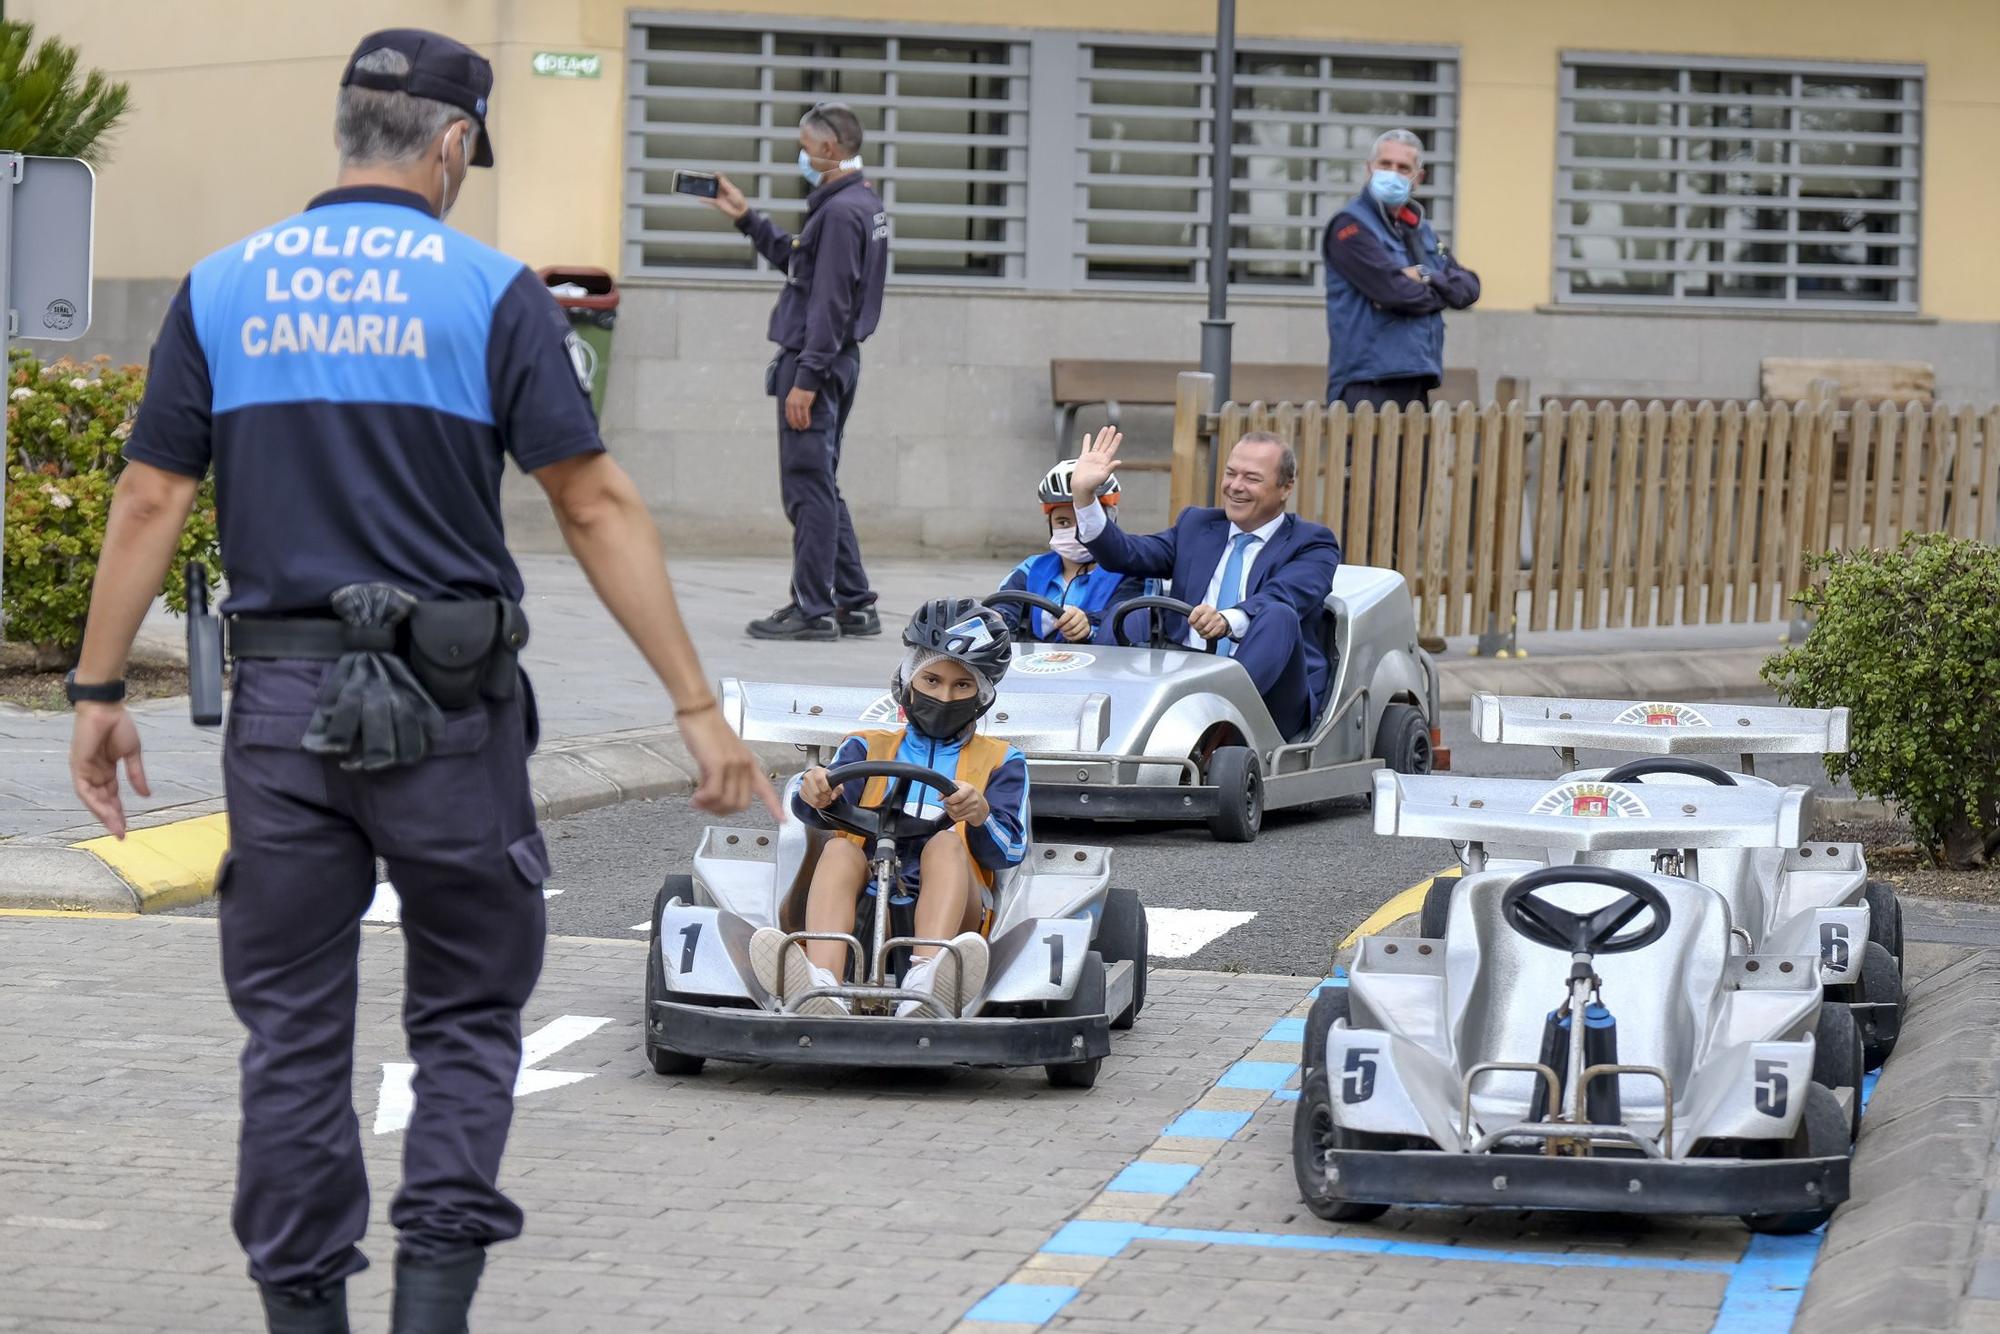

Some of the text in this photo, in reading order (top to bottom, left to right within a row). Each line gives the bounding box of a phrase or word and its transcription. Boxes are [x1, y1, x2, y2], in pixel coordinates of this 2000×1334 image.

[243, 226, 446, 264] POLICIA
[266, 267, 409, 304] LOCAL
[241, 313, 427, 359] CANARIA
[678, 922, 703, 975] 1
[1043, 934, 1065, 987] 1
[1819, 923, 1850, 973] 6
[1342, 1048, 1380, 1105] 5
[1754, 1059, 1789, 1118] 5
